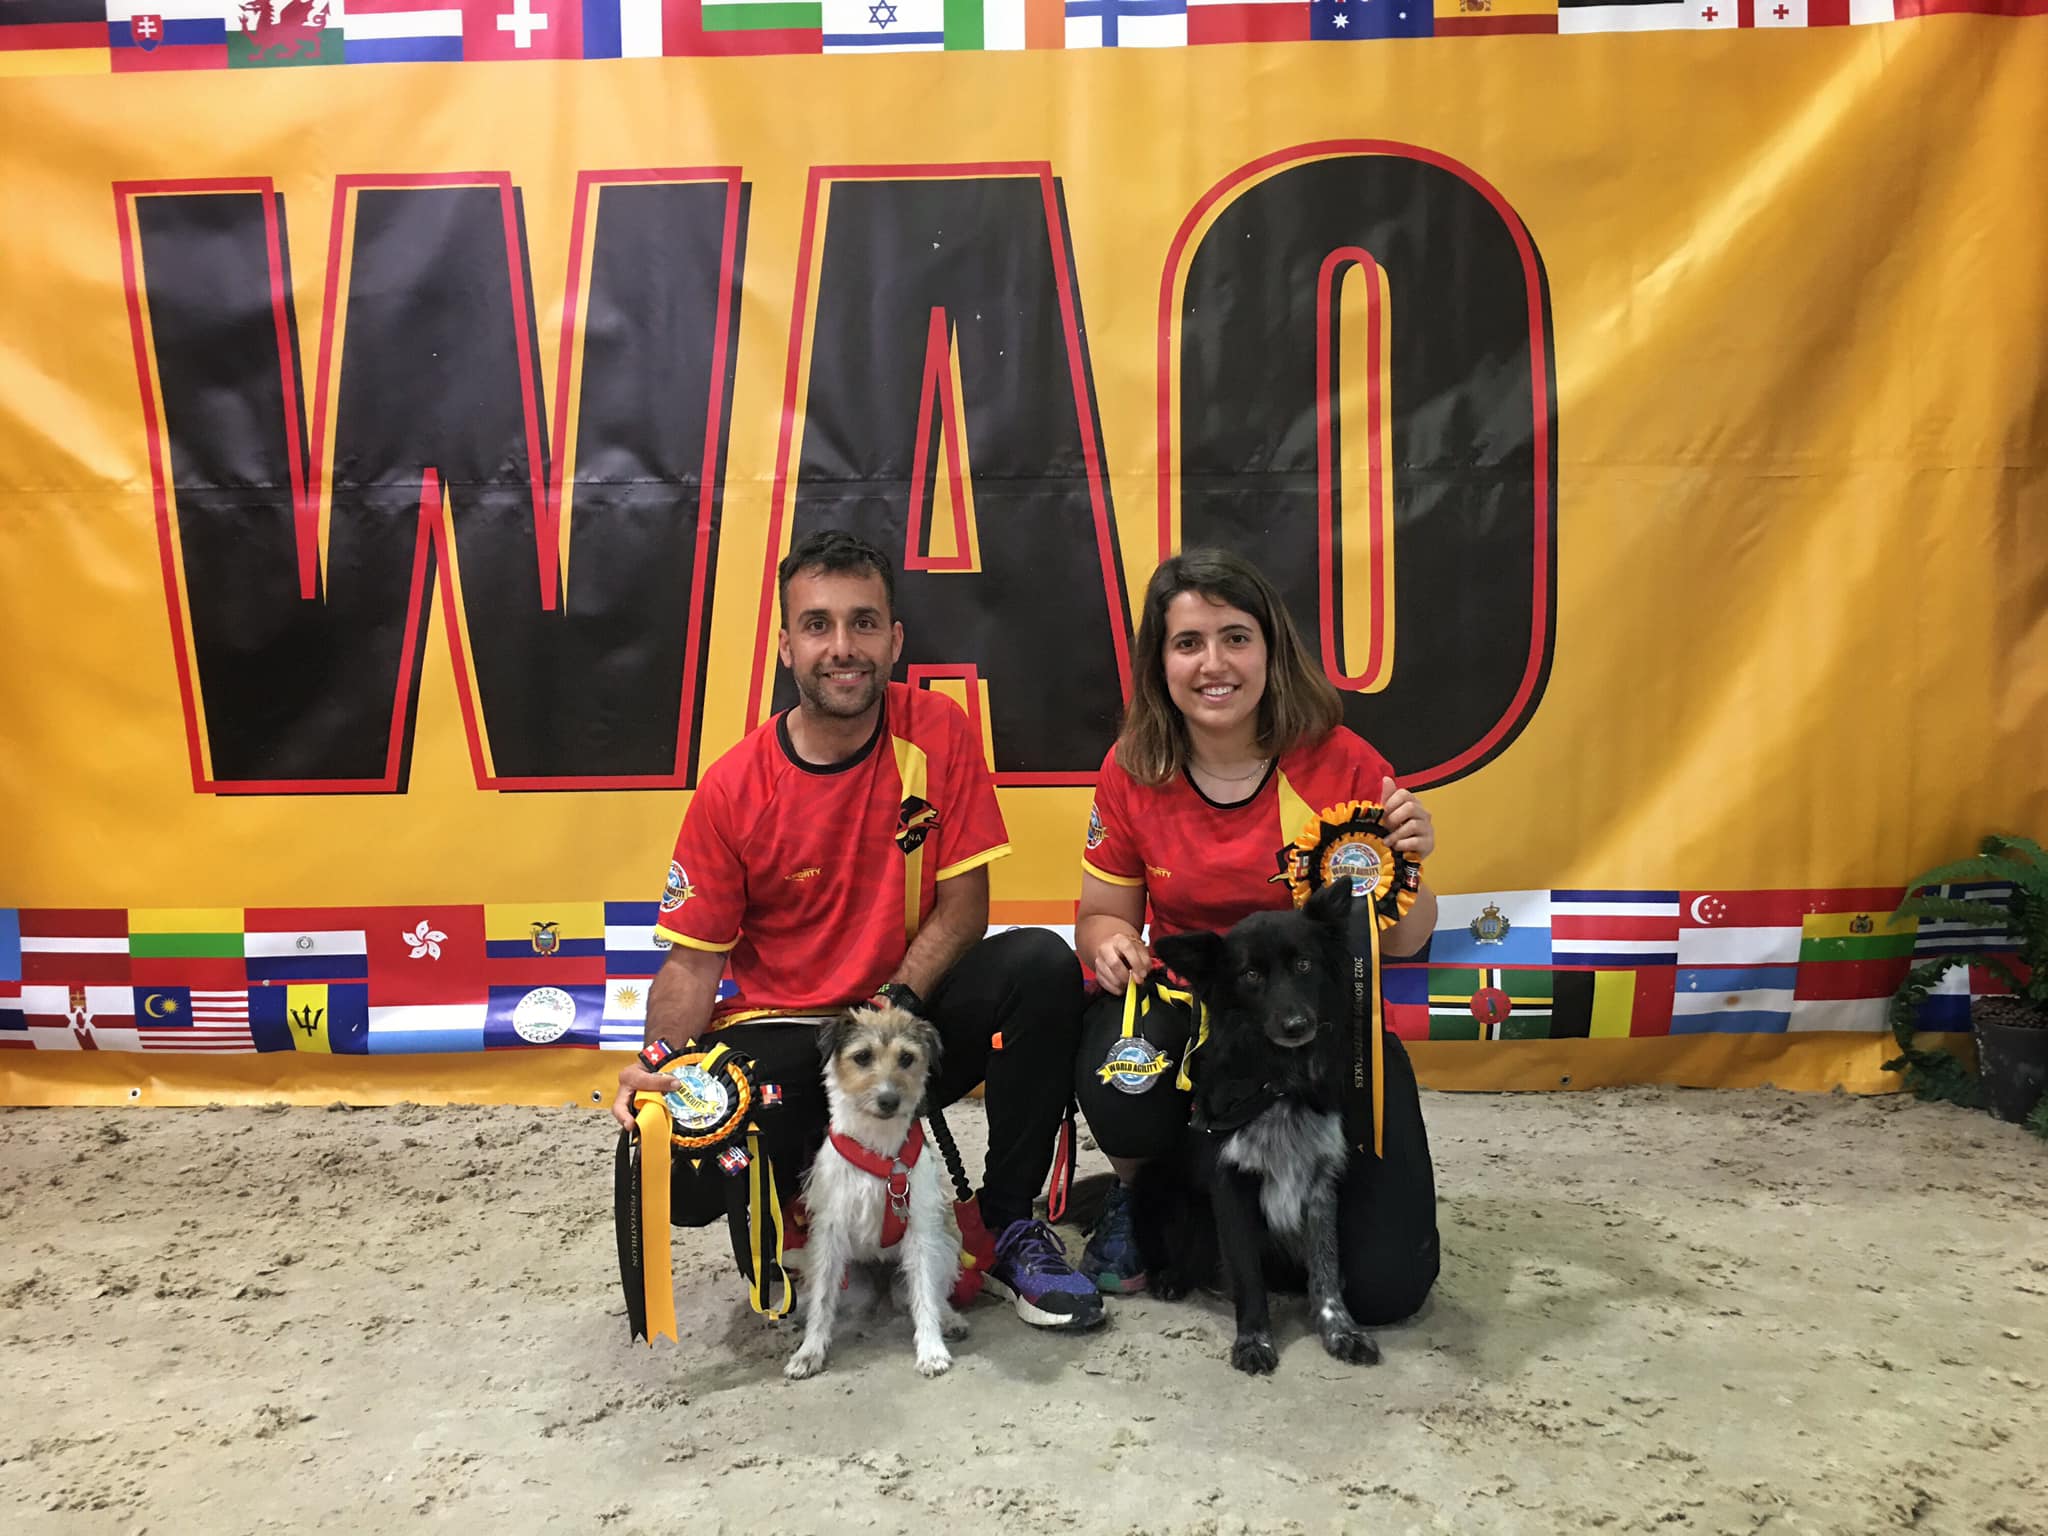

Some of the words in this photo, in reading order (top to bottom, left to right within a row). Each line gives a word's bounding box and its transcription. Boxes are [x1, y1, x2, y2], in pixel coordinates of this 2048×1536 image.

[112, 138, 1557, 793] WAO
[1353, 956, 1364, 978] 2022
[1109, 1063, 1132, 1073] WORLD
[1133, 1063, 1158, 1073] AGILITY
